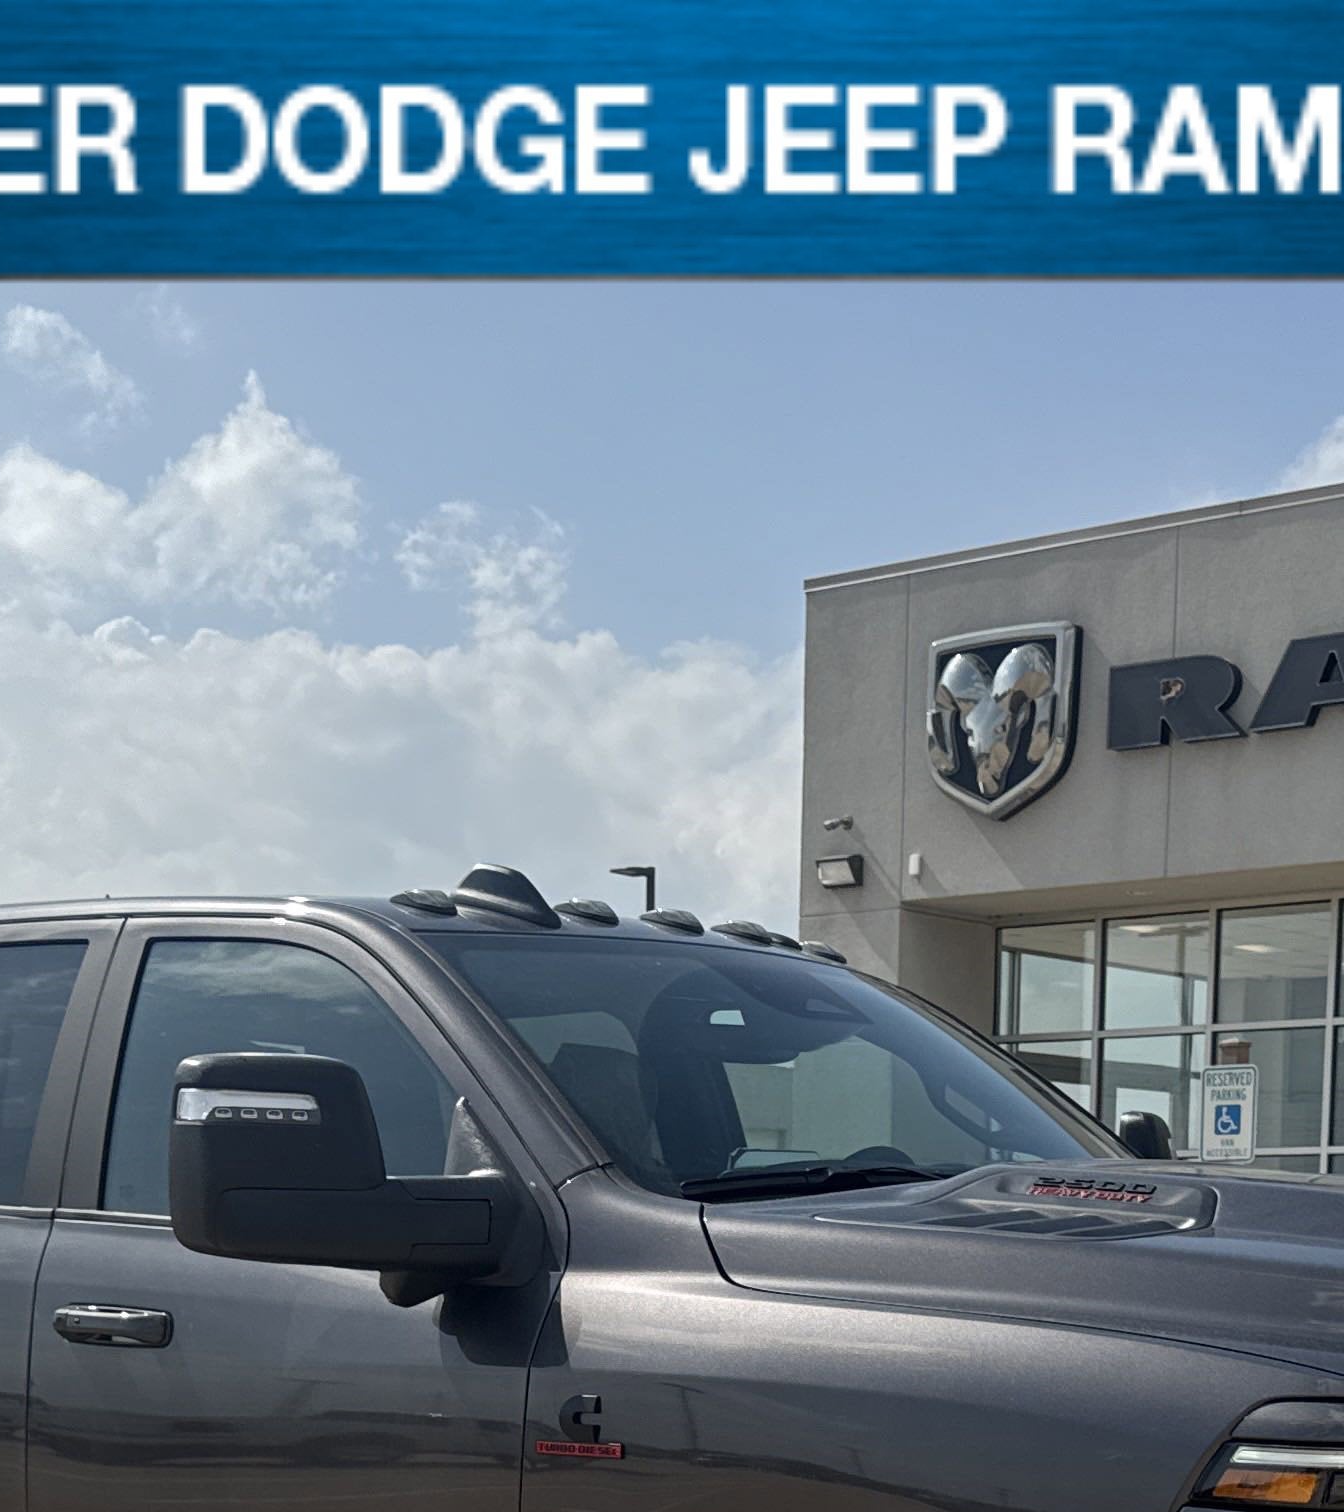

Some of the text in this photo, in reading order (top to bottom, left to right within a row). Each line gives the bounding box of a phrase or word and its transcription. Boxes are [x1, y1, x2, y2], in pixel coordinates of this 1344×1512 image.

[1206, 1072, 1252, 1087] RESERVED
[1210, 1088, 1247, 1101] PARKING
[1032, 1177, 1157, 1195] 2500
